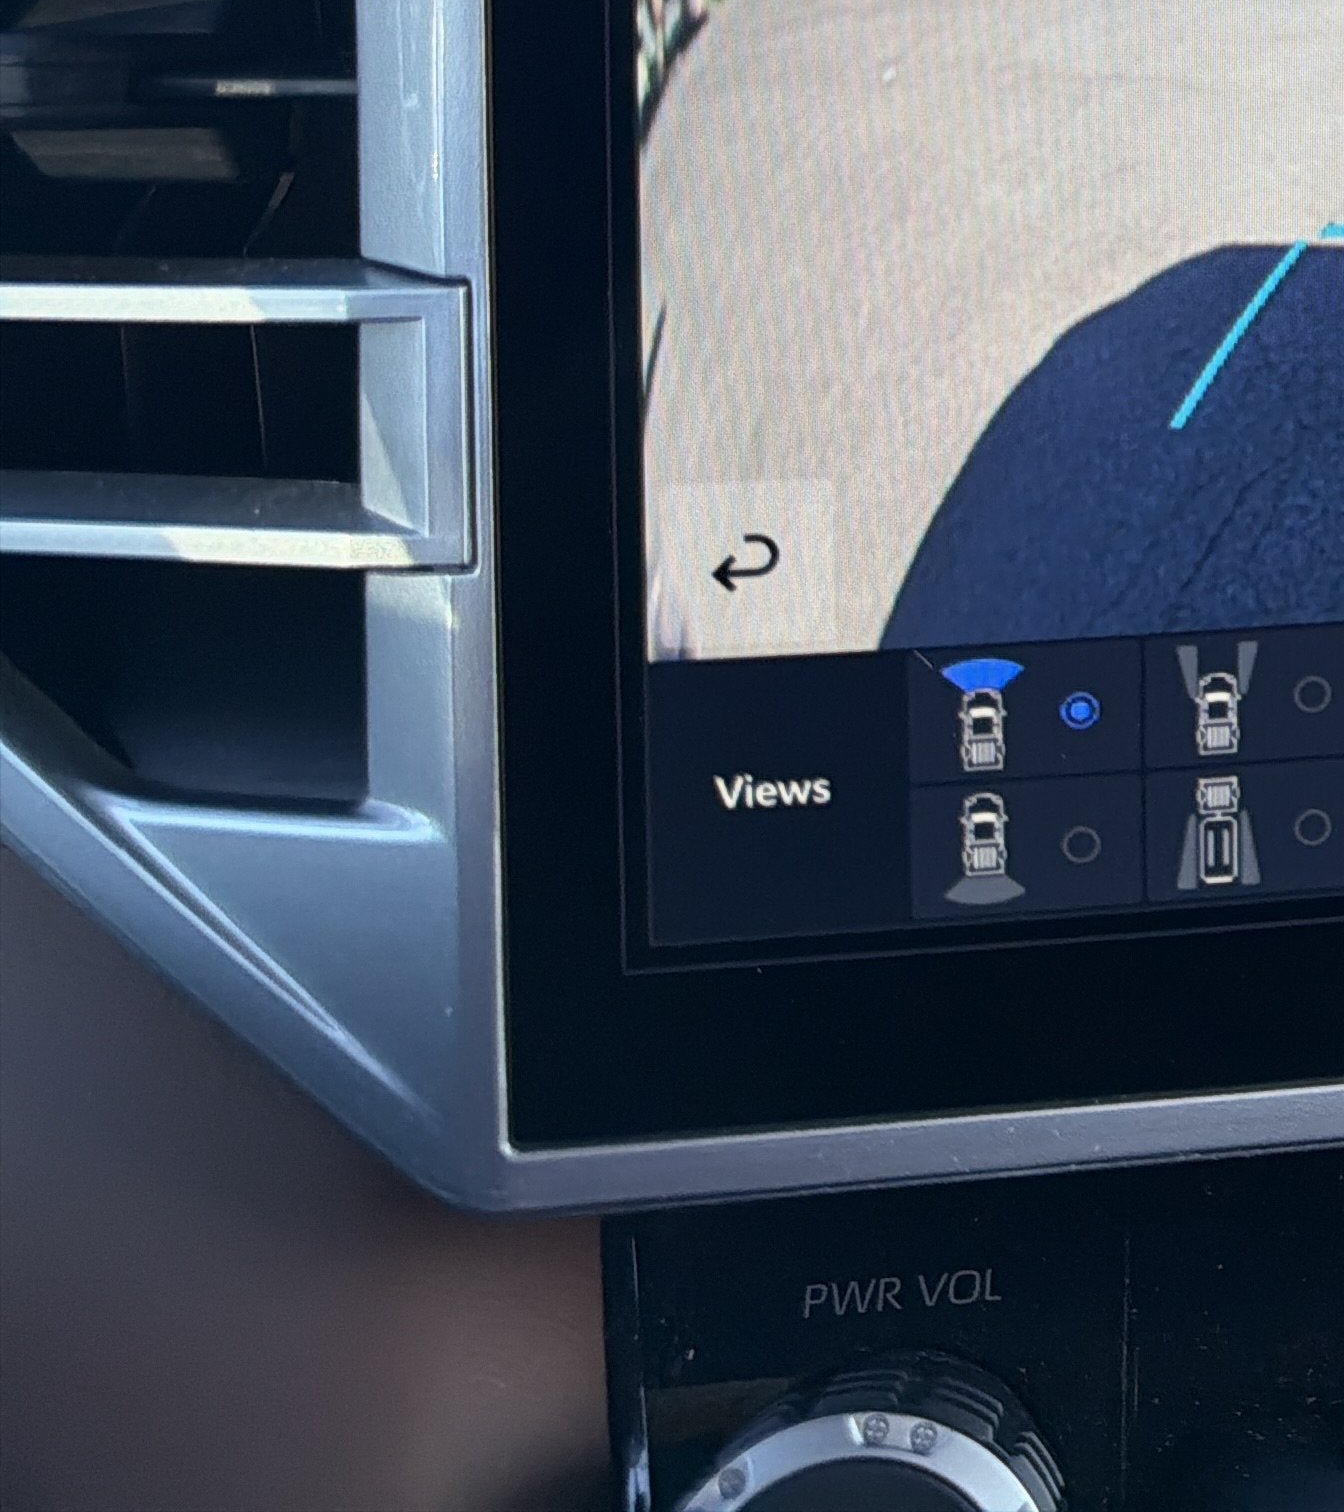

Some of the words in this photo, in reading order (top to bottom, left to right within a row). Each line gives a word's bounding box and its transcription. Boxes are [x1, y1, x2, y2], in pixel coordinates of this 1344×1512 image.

[713, 772, 831, 809] Views
[803, 1276, 903, 1319] PWR
[918, 1268, 1002, 1307] VOL
